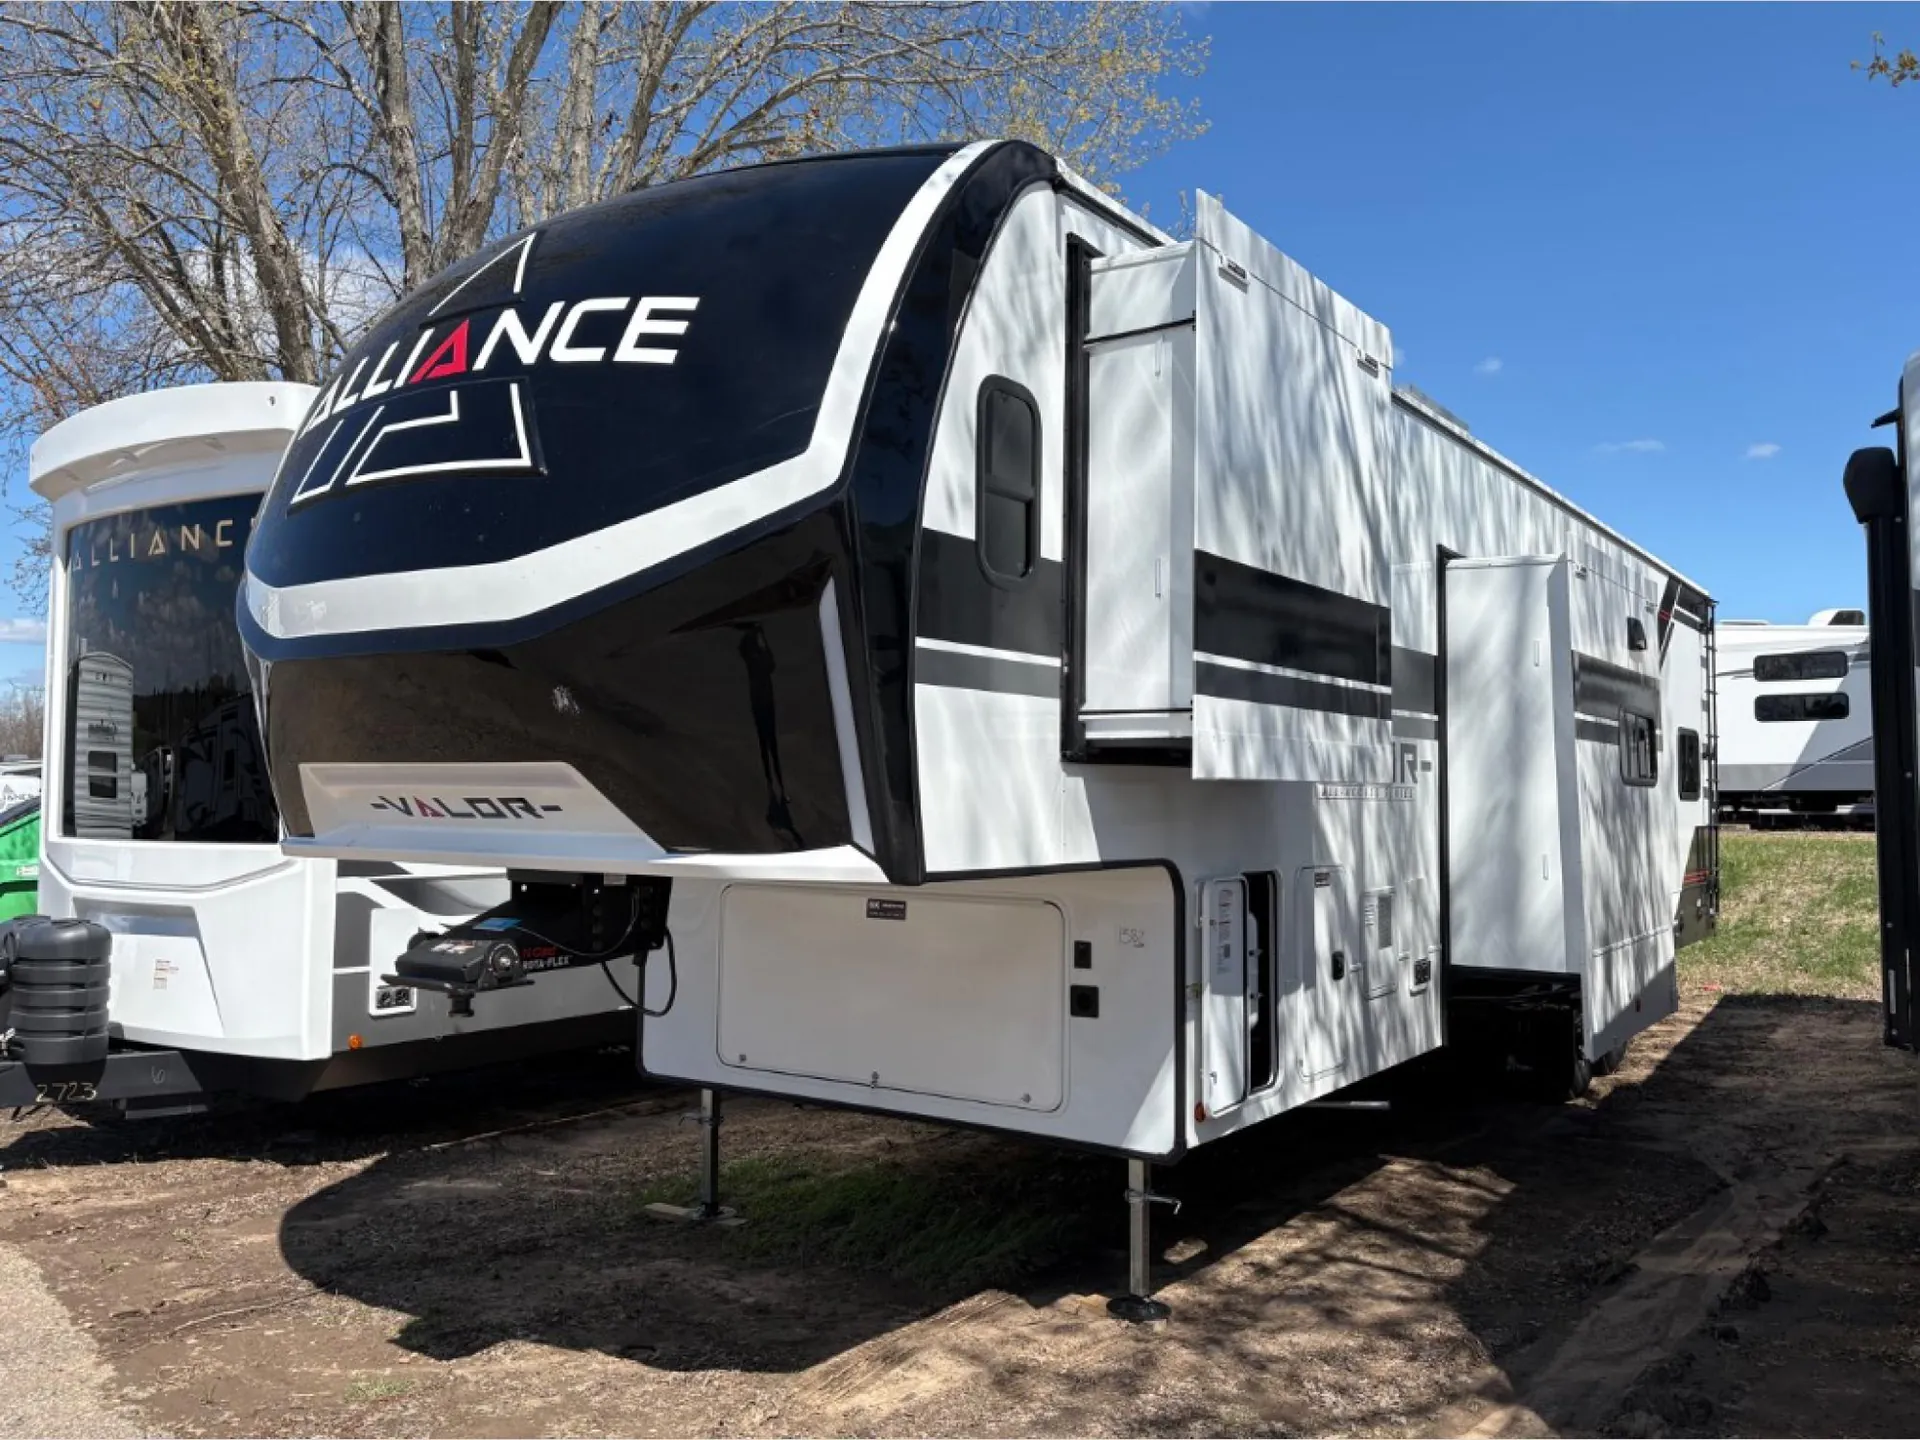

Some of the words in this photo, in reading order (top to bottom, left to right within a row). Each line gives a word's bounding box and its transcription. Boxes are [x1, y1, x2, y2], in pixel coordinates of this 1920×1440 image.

[299, 295, 700, 437] ALLIANCE
[73, 517, 256, 571] ALLIANC
[35, 1082, 97, 1102] 2723
